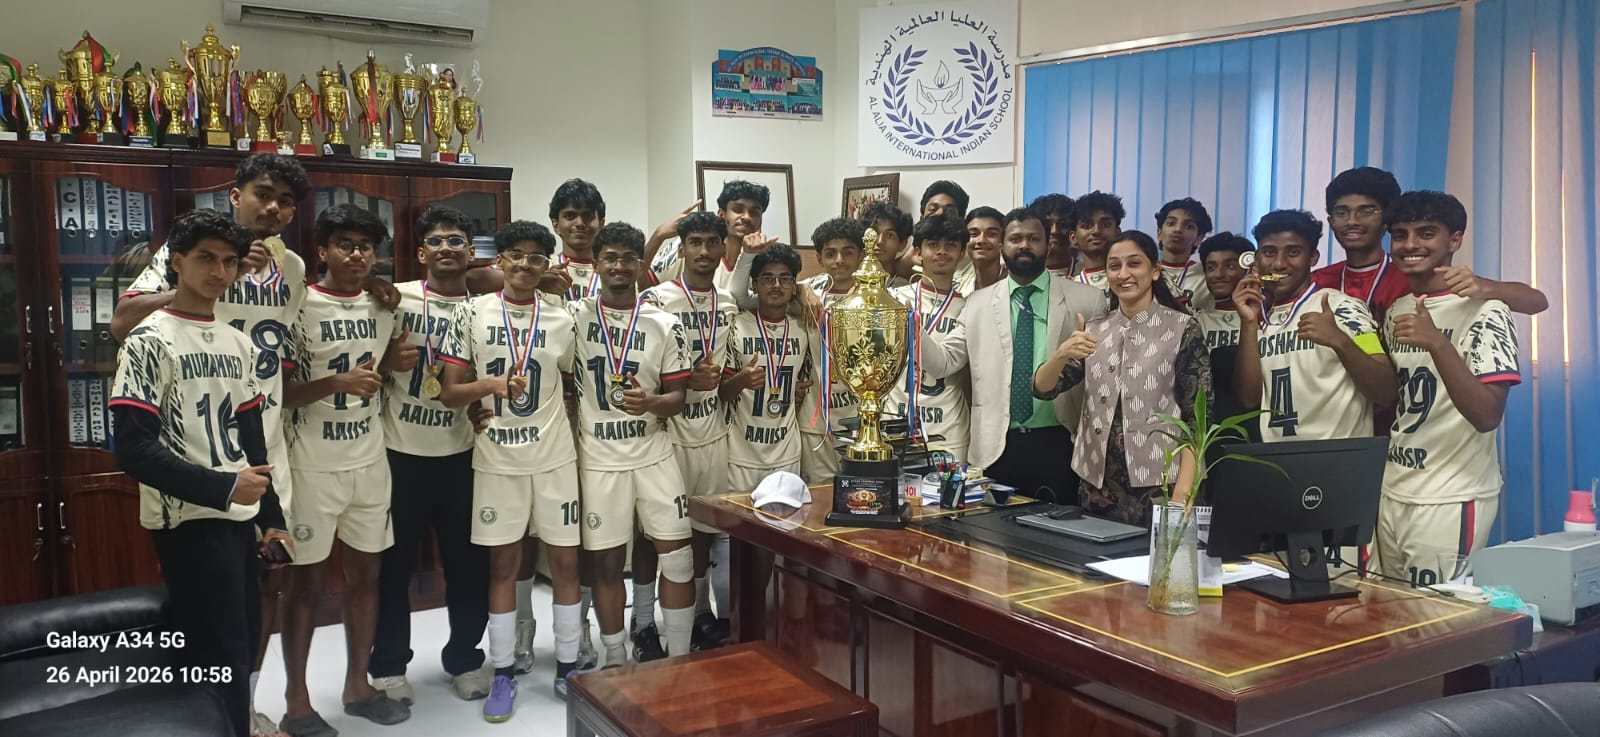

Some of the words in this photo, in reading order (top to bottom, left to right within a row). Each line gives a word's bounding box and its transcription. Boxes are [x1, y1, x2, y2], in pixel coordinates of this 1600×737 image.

[895, 11, 944, 36] العالمية
[950, 10, 988, 34] العليا
[866, 34, 897, 85] الهندية
[988, 30, 1011, 79] مدرسة
[869, 96, 877, 110] AL
[989, 87, 1013, 130] SCHOOL
[872, 111, 886, 132] ALIA
[882, 132, 959, 160] INTERNATIONAL
[960, 131, 992, 155] INDIAN
[320, 318, 377, 342] AERON
[587, 322, 646, 352] RHN
[1206, 330, 1240, 347] ABE
[179, 353, 243, 380] MUHAMMED
[486, 358, 541, 417] 10
[1268, 367, 1299, 436] 4
[399, 403, 454, 427] AAIISR
[196, 392, 244, 467] 16
[487, 426, 540, 445] AAIISR
[595, 421, 647, 441] AAIISR
[561, 500, 578, 525] 10
